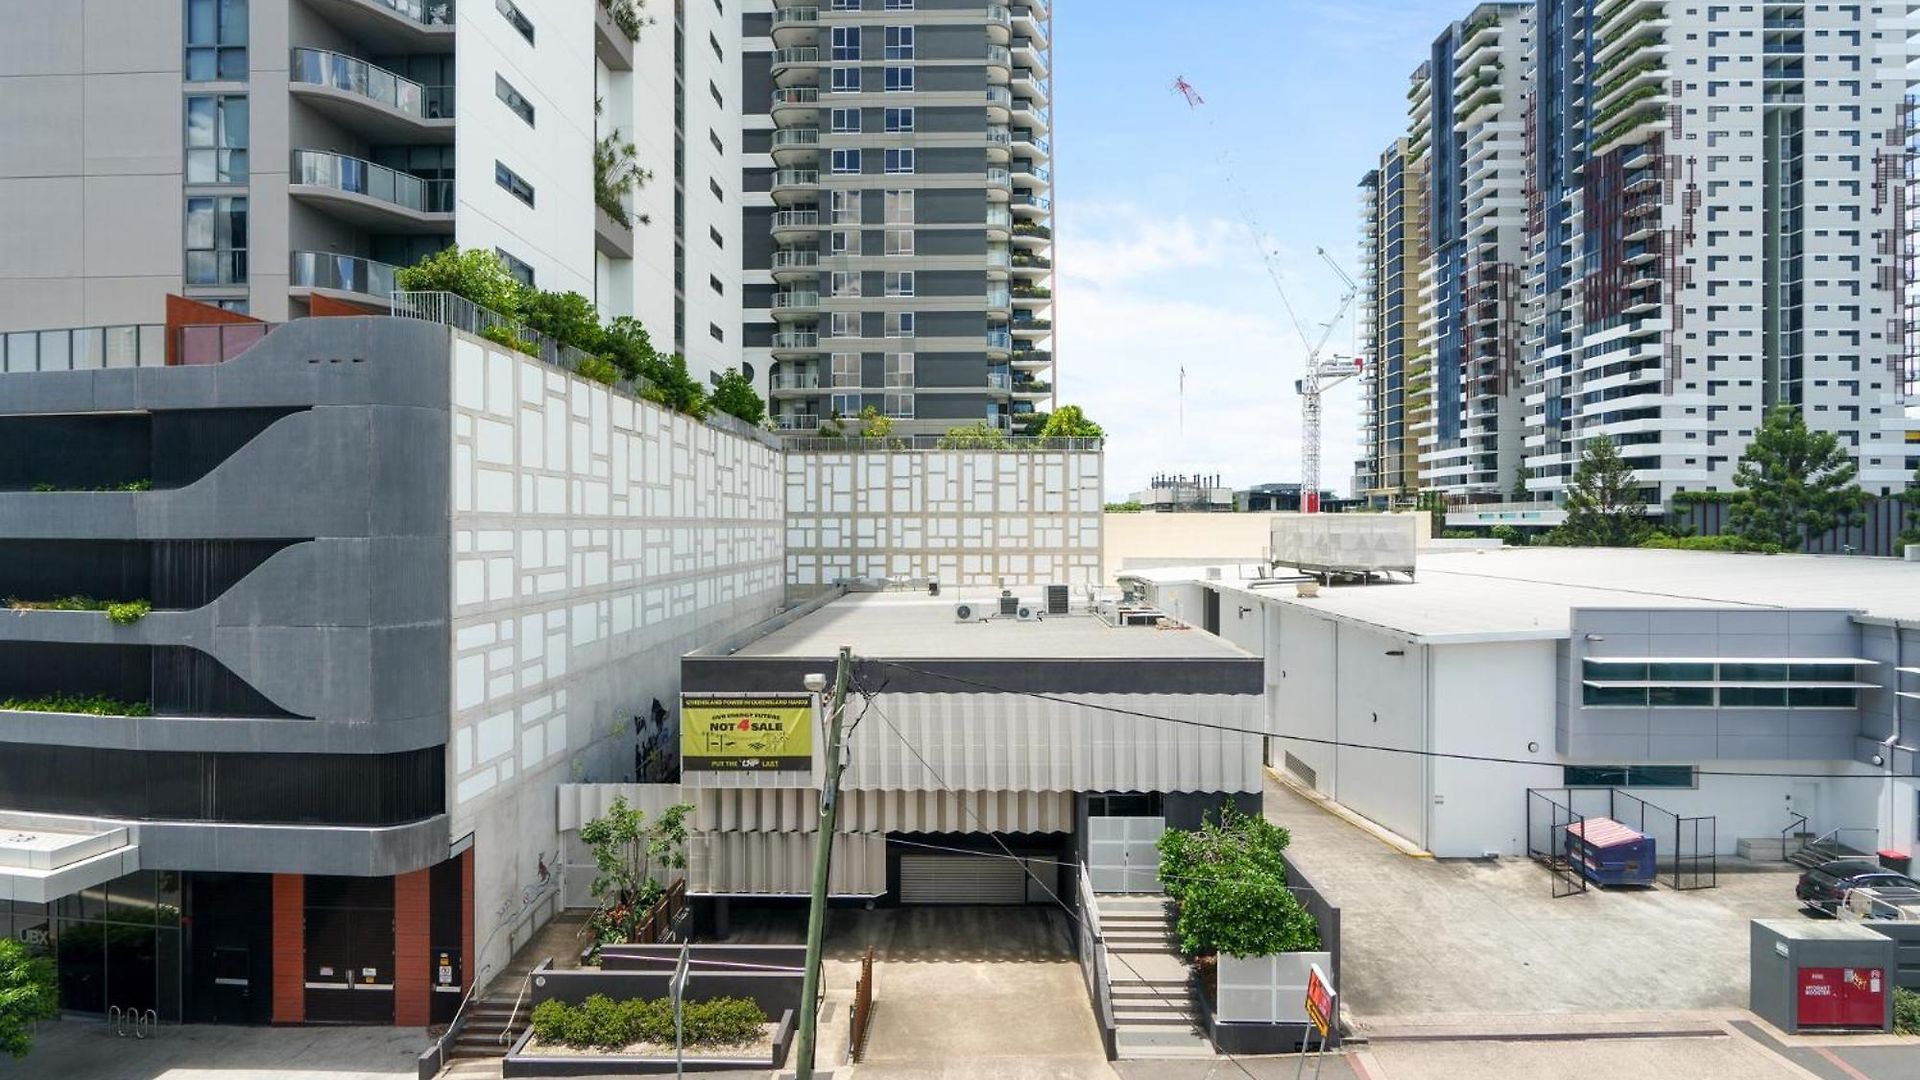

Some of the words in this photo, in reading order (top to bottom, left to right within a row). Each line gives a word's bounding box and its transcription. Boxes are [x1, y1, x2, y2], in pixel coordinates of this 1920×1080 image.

[710, 722, 735, 731] NOT
[737, 719, 750, 731] 4
[751, 722, 783, 731] SALE
[763, 760, 778, 768] LAST
[20, 929, 49, 945] UBX
